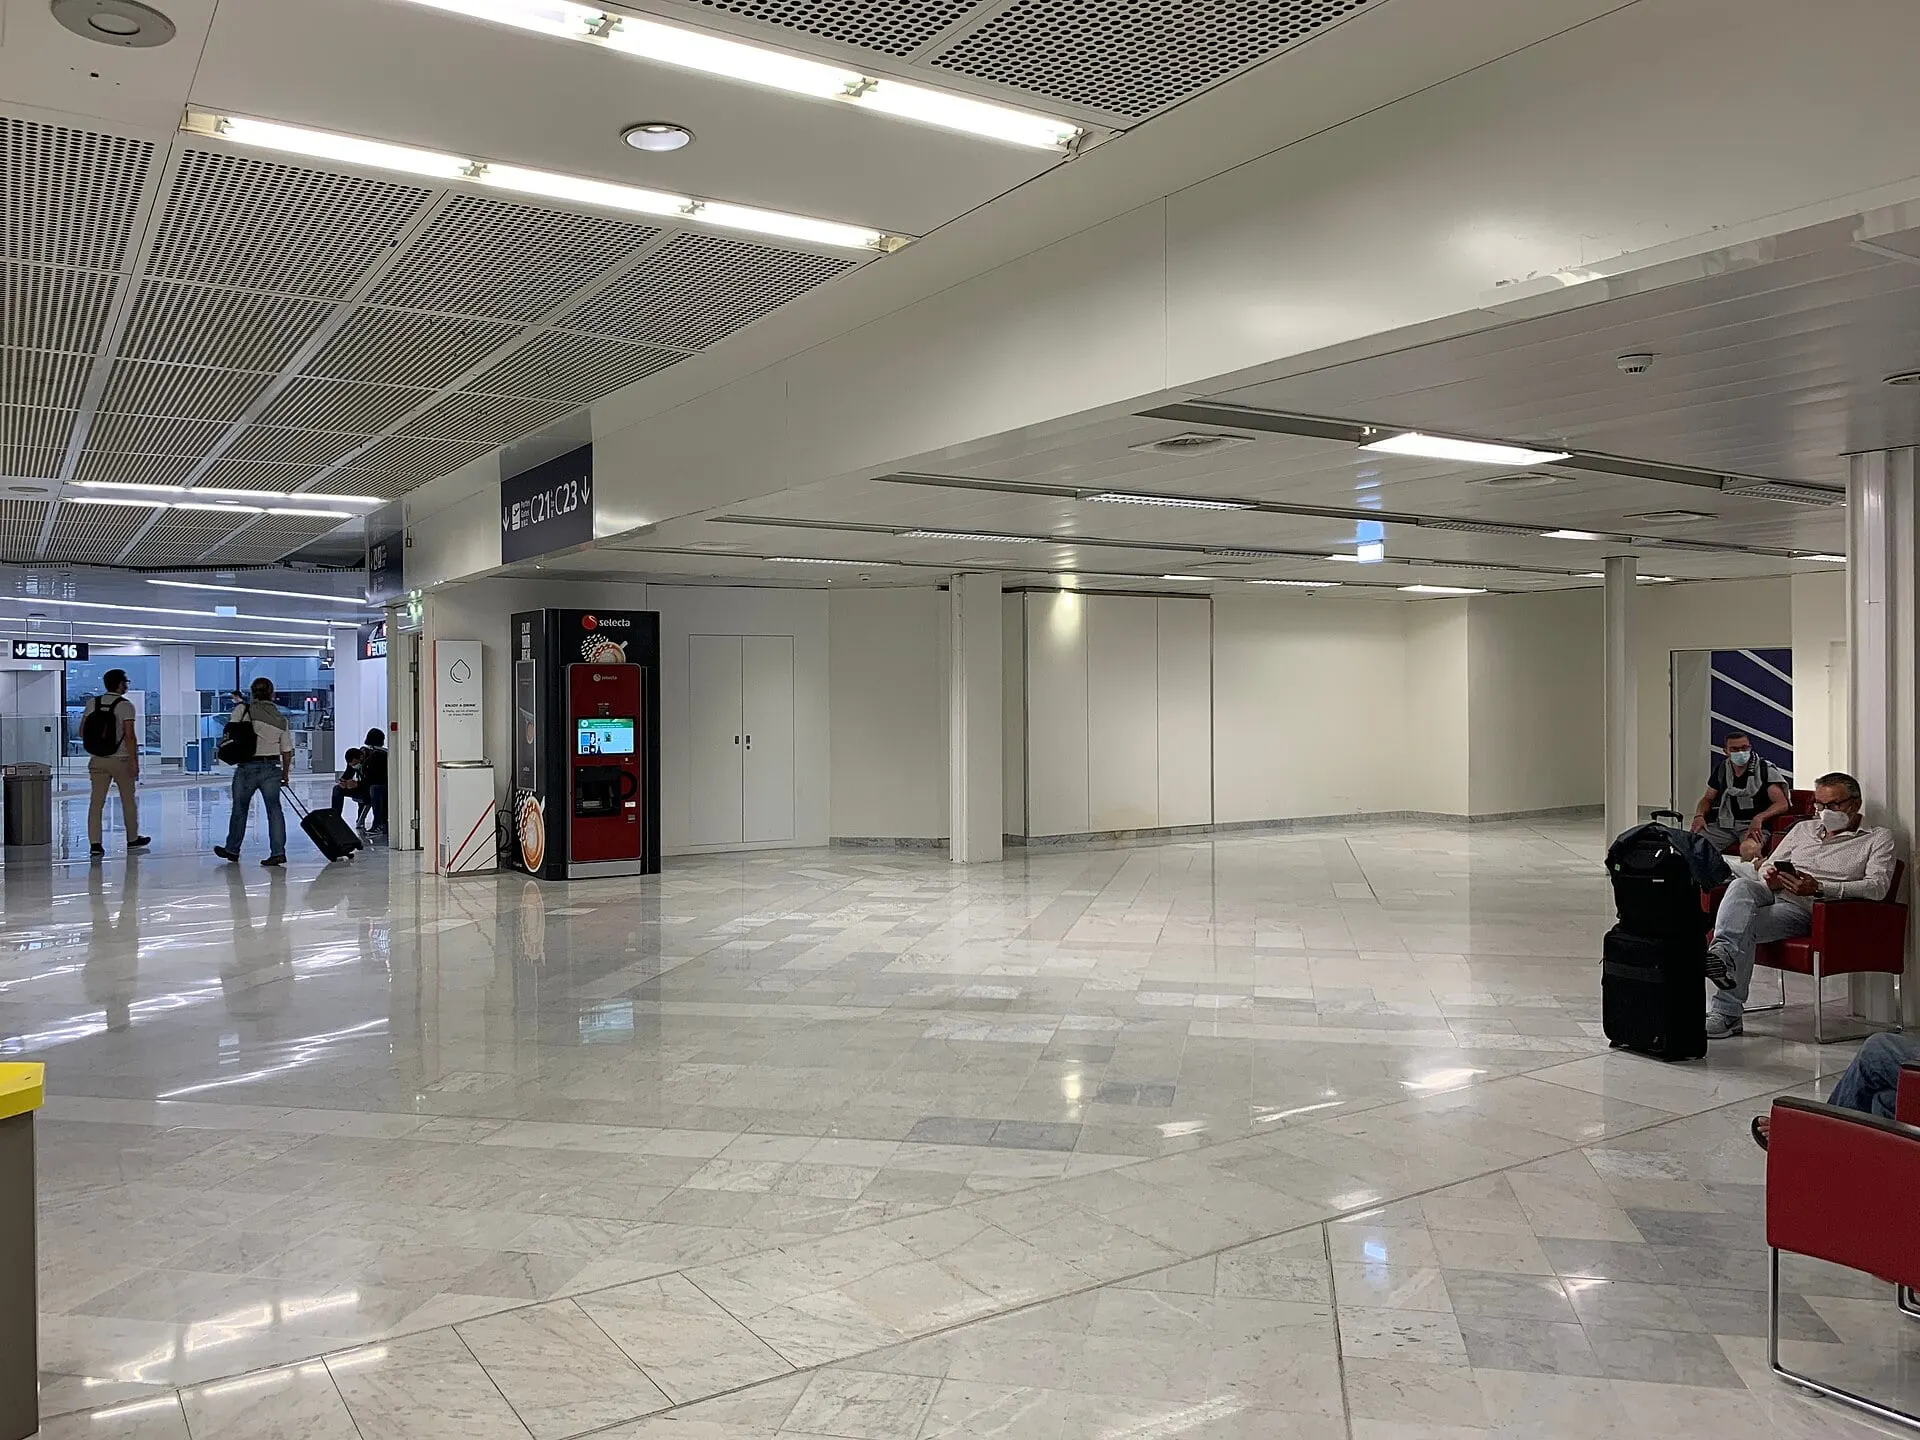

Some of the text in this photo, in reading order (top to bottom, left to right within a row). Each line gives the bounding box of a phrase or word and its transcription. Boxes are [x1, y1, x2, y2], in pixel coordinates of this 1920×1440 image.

[530, 490, 550, 524] C21
[555, 480, 578, 515] C23
[598, 618, 631, 627] selecta
[51, 643, 78, 659] C16
